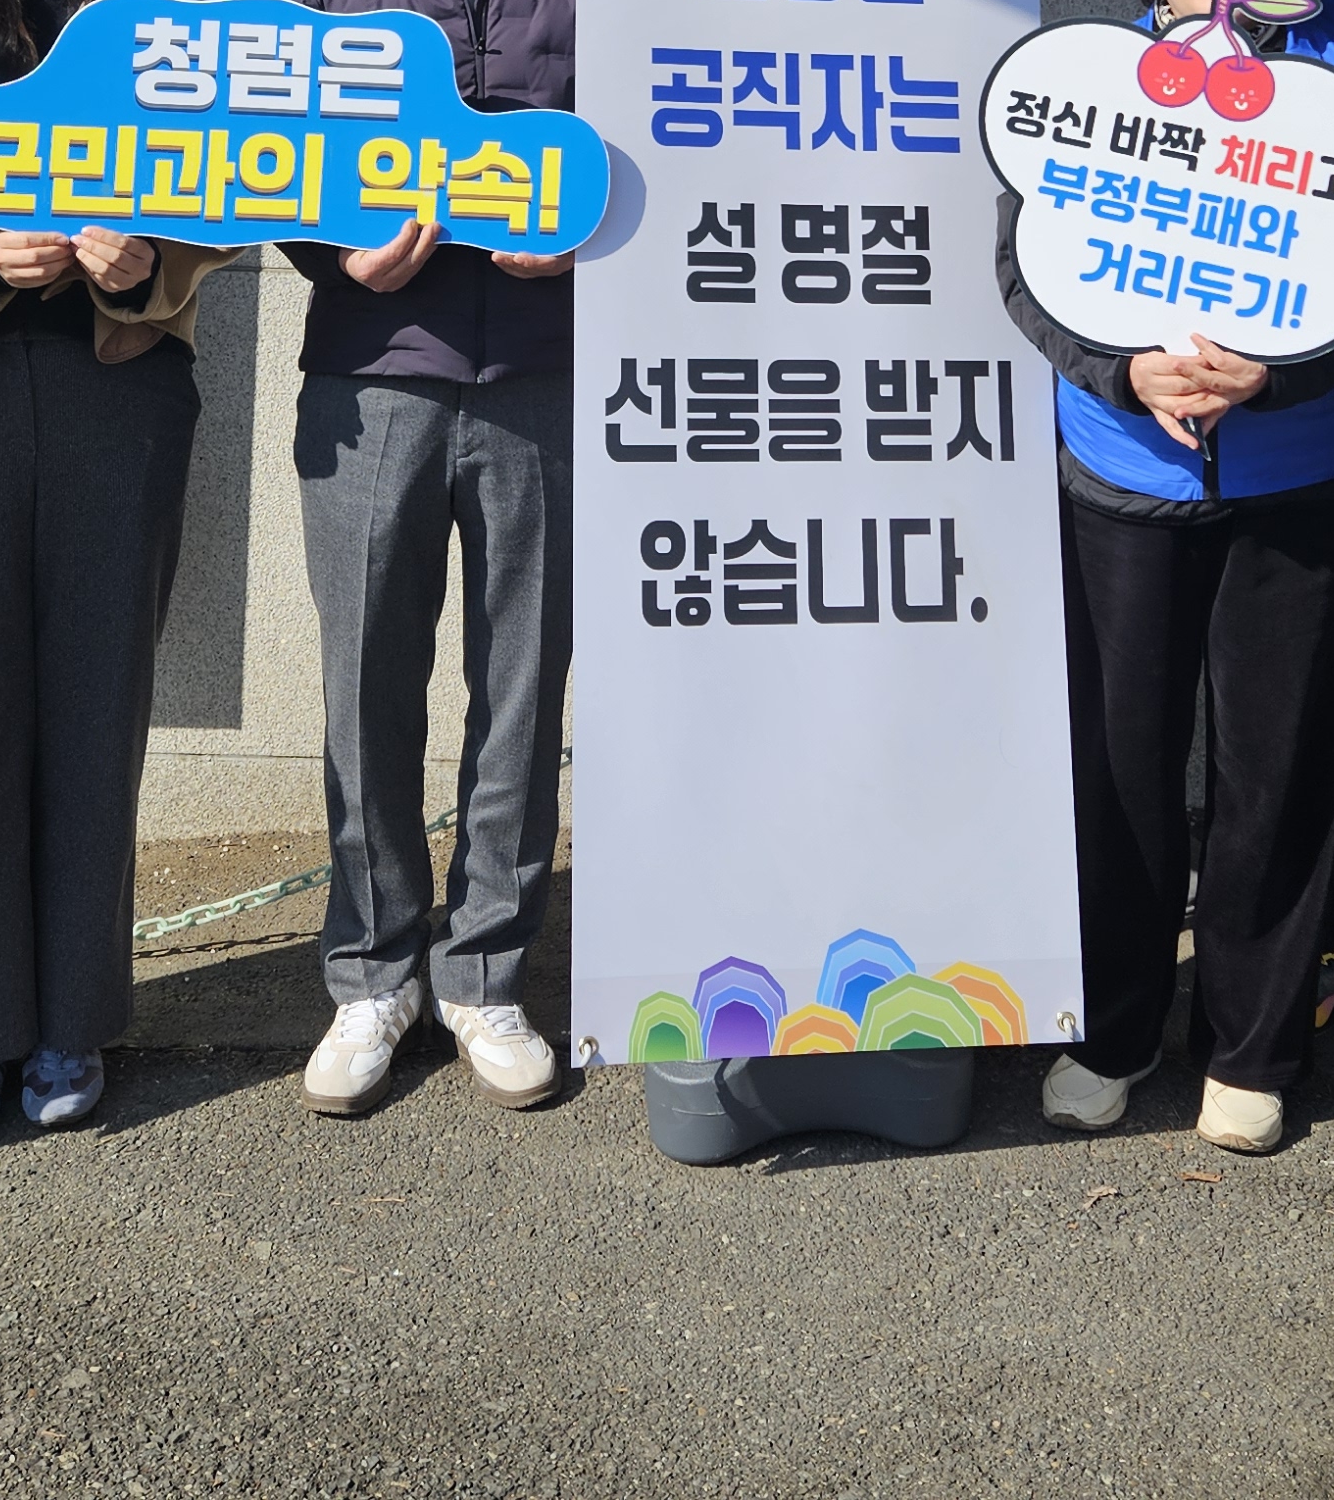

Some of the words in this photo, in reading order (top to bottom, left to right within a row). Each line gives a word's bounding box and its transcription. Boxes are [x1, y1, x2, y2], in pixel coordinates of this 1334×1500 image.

[132, 17, 405, 120] 청렴은
[651, 47, 960, 153] 공직자는
[1006, 90, 1098, 149] 정신
[1109, 113, 1207, 171] 바짝
[357, 137, 563, 235] 약속!
[1037, 158, 1301, 259] 부정부패와
[686, 202, 756, 304] 설
[780, 203, 932, 305] 명절
[1079, 237, 1308, 331] 거리두기!
[605, 357, 842, 462] 선물을
[864, 359, 1015, 462] 받지
[640, 518, 988, 627] 않습니다.
